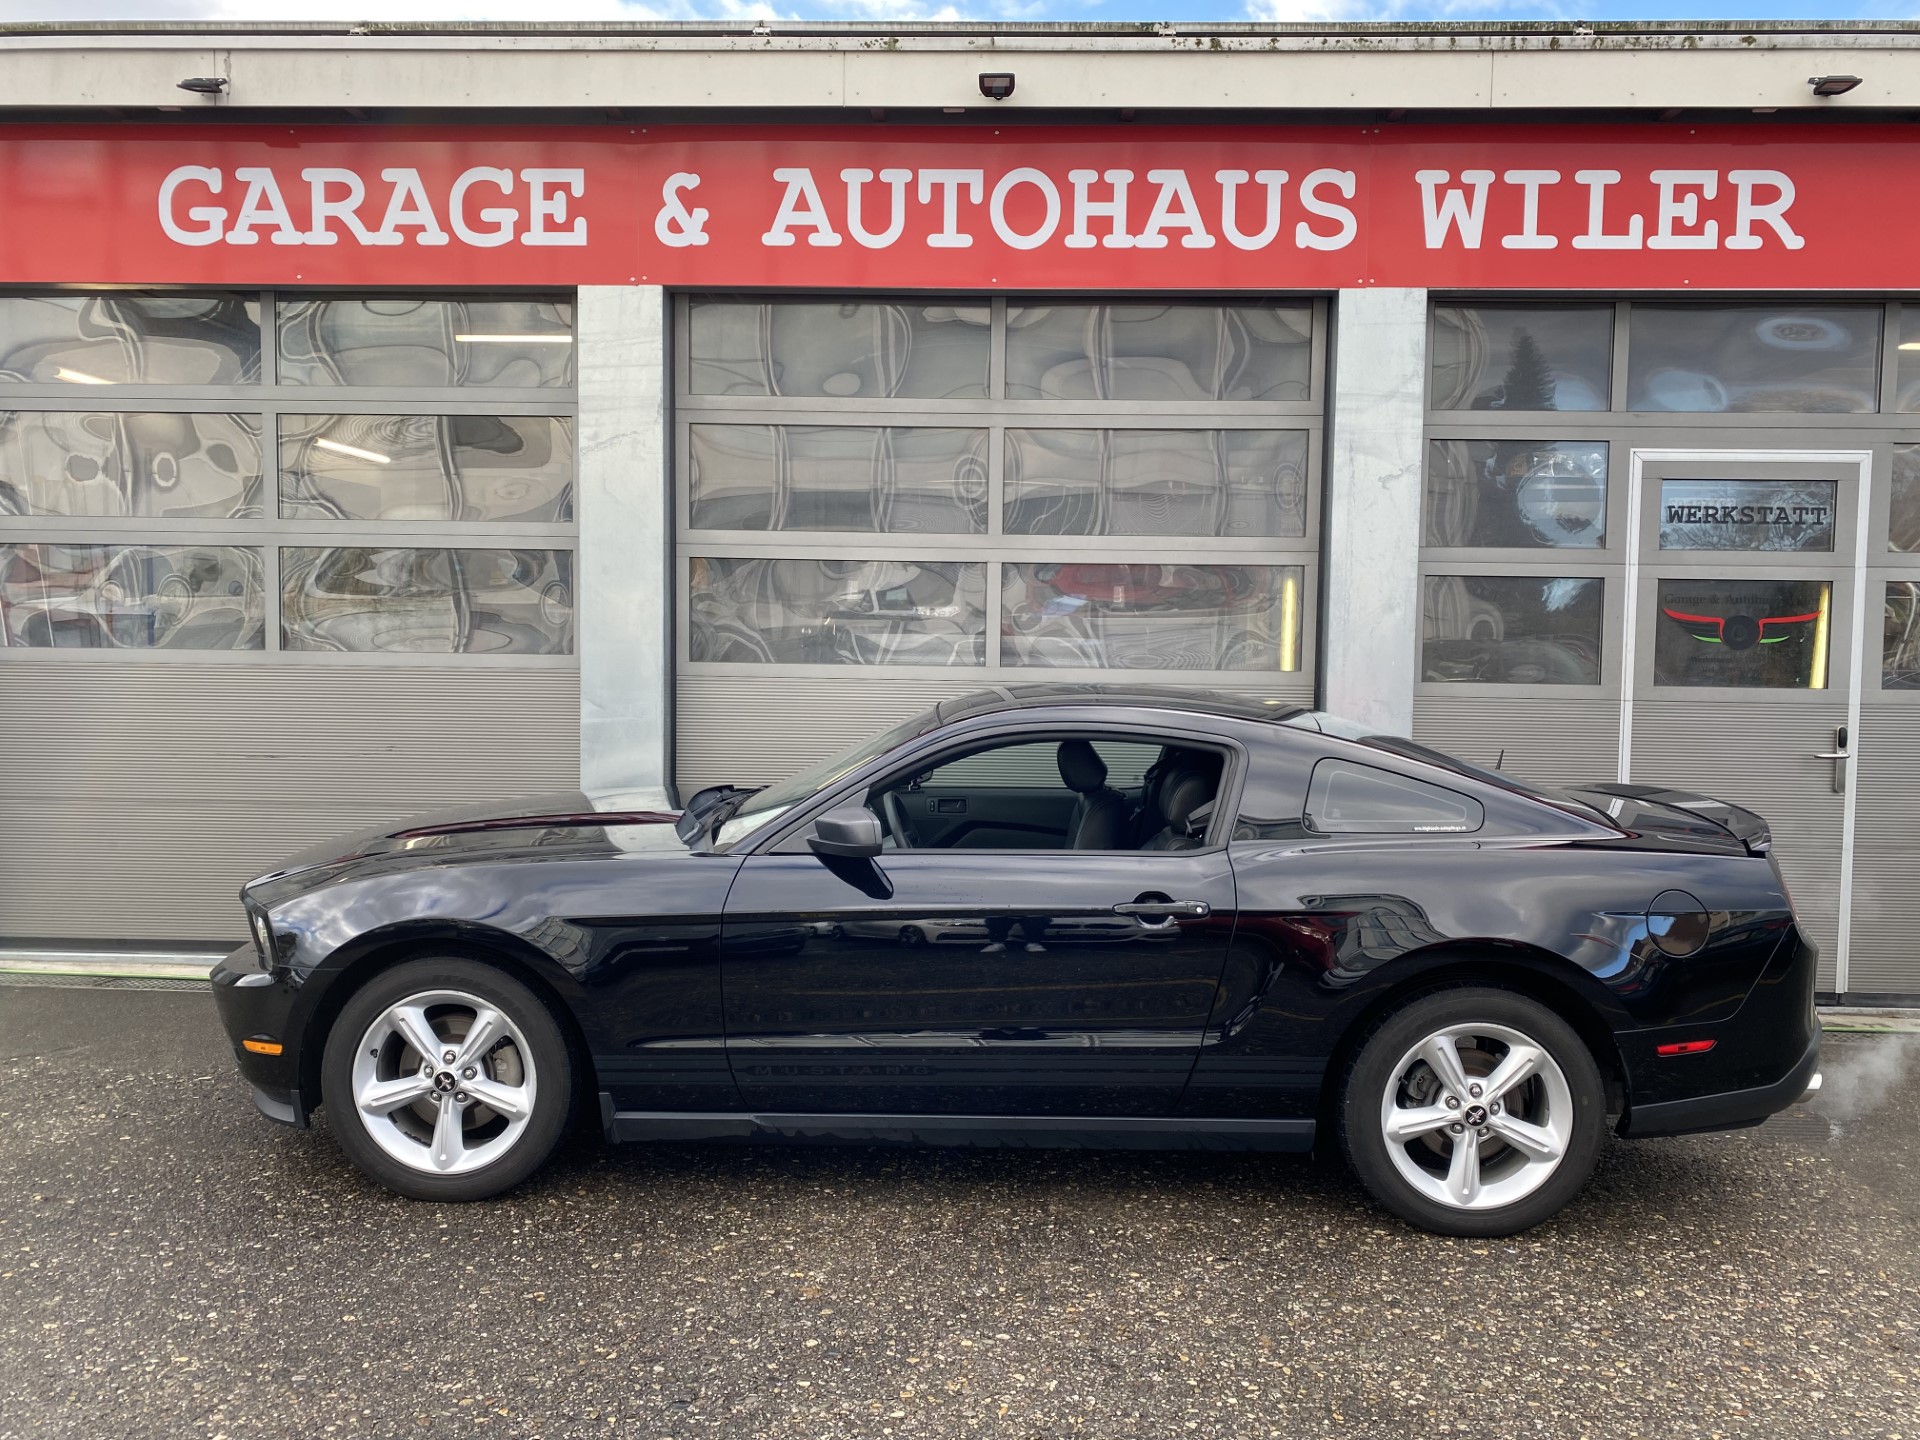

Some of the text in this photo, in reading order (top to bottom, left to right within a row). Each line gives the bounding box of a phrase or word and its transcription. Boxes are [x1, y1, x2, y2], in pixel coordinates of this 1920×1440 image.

[158, 165, 1806, 251] GARAGE & AUTOHAUS WILER
[1667, 506, 1827, 525] WERKSTATT
[1664, 593, 1706, 607] Garage
[1710, 593, 1720, 605] &
[1725, 593, 1774, 606] Autoha
[754, 1065, 930, 1076] MUSTANG
